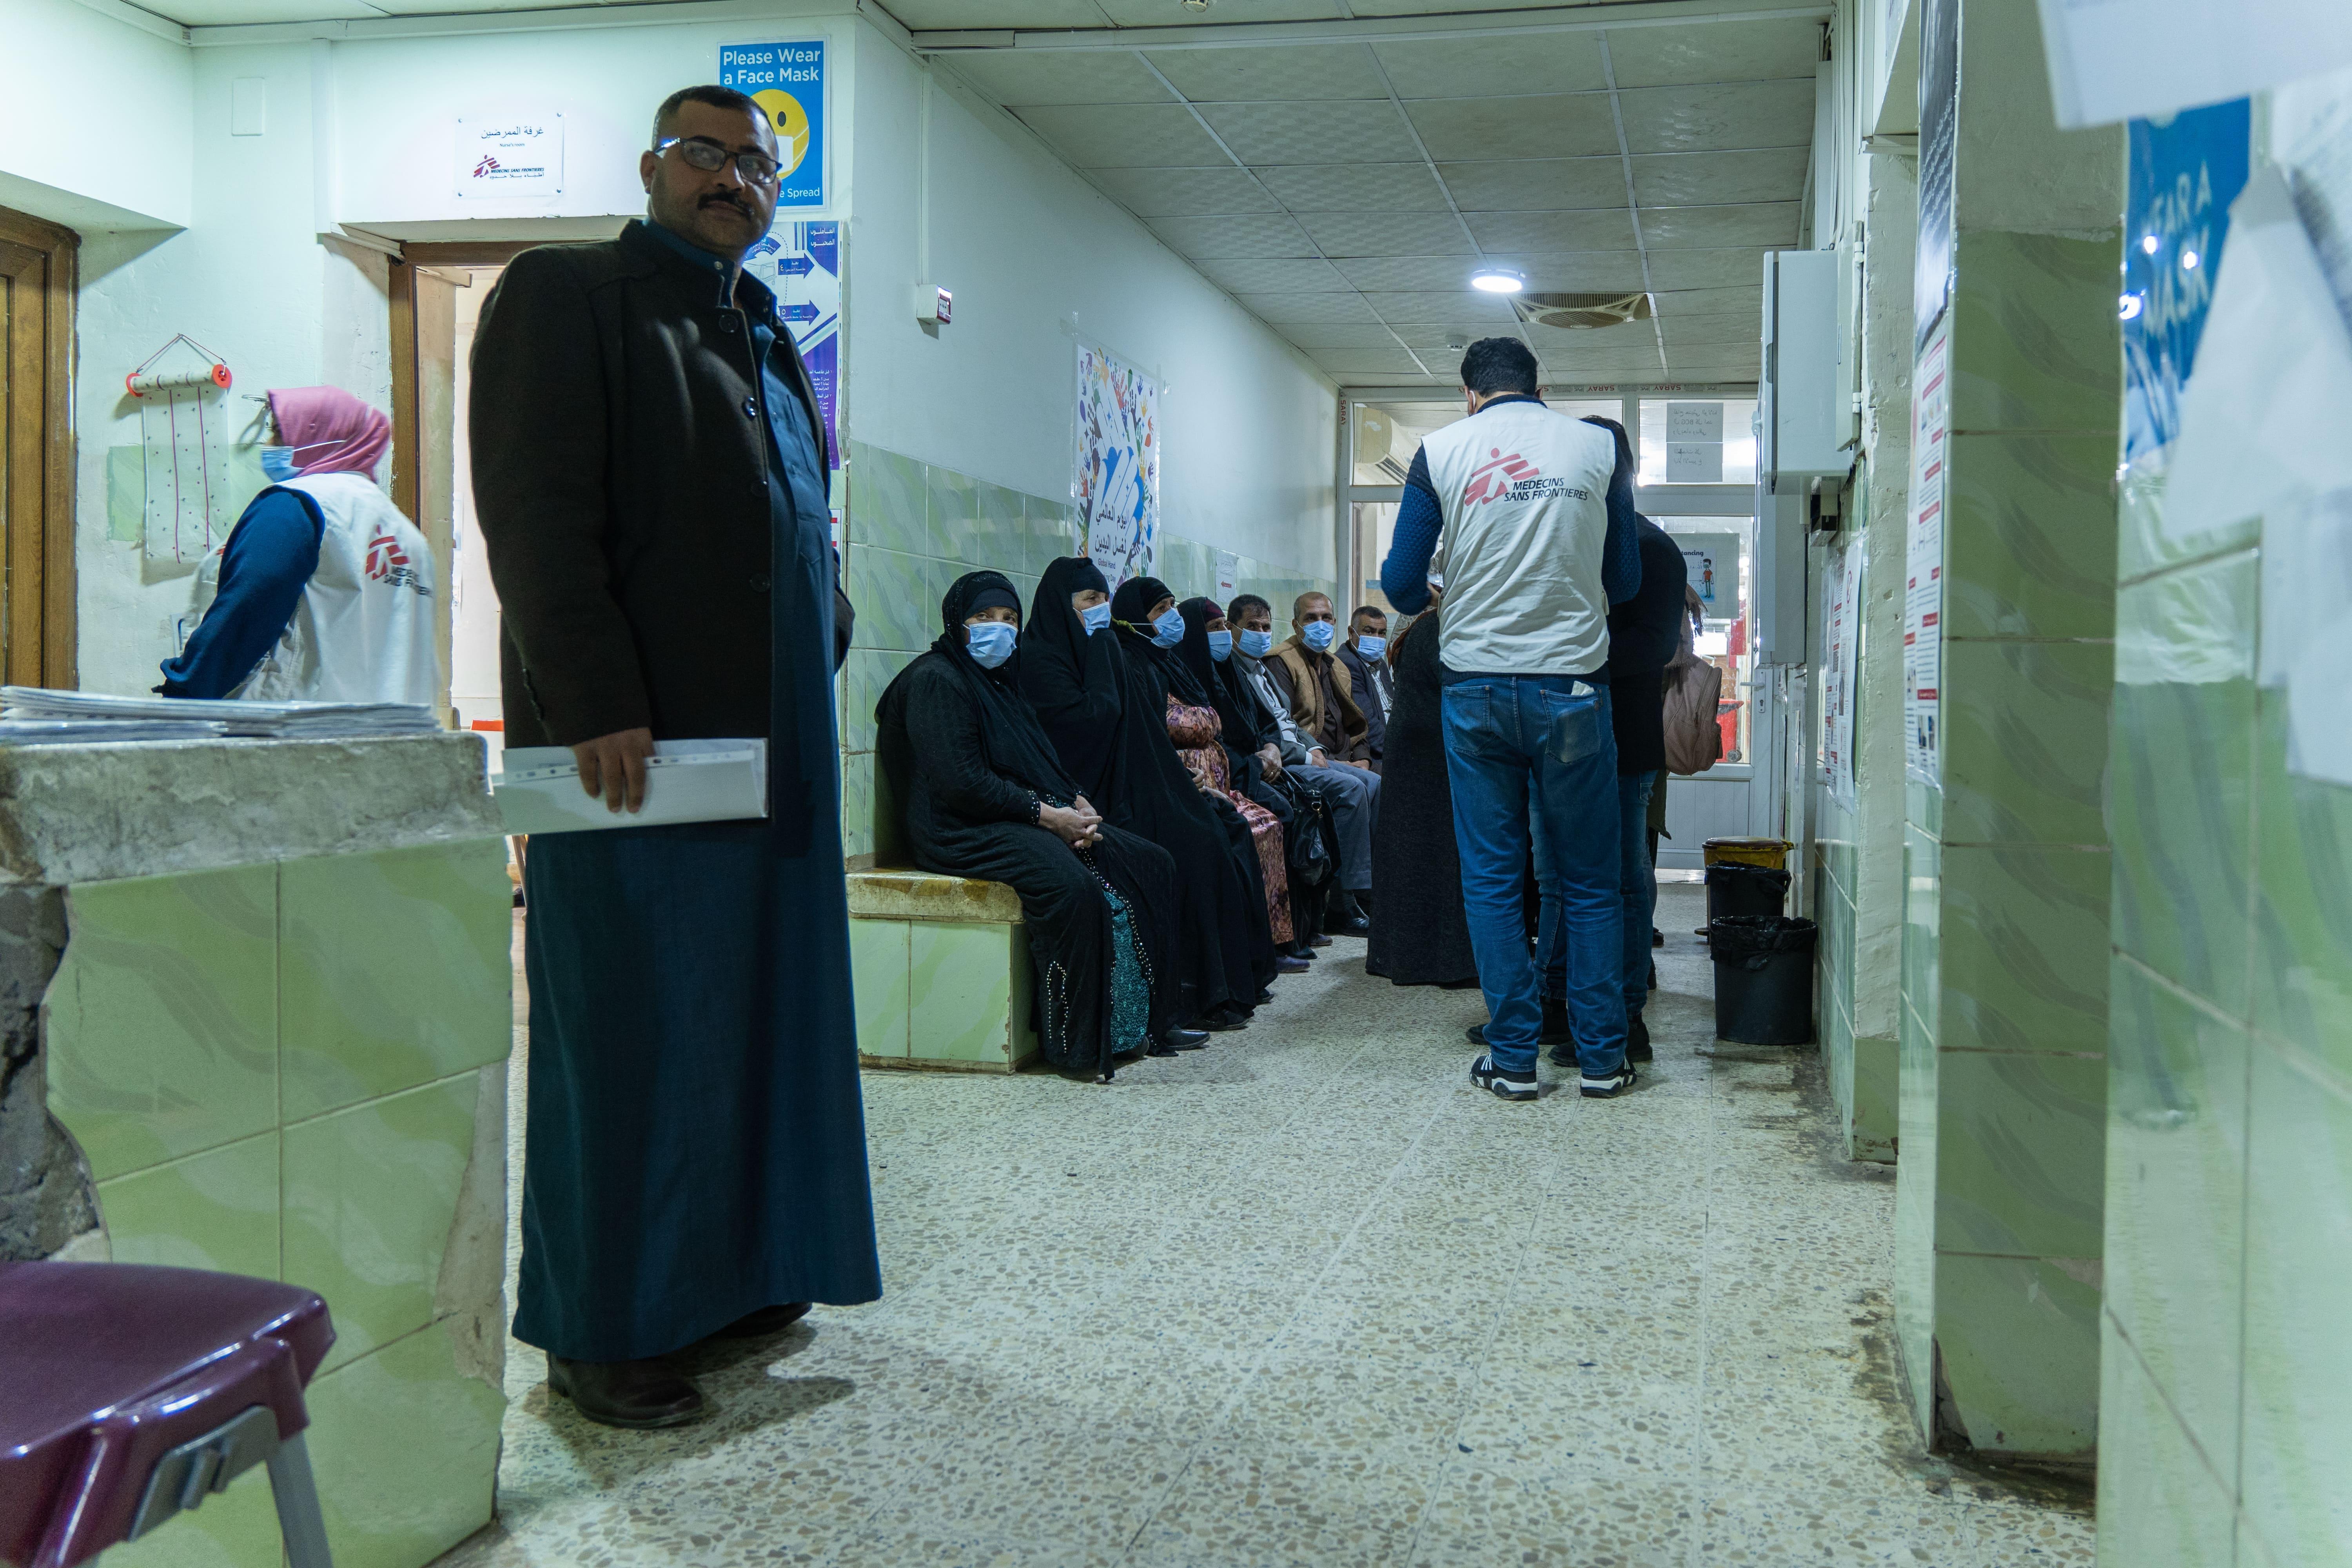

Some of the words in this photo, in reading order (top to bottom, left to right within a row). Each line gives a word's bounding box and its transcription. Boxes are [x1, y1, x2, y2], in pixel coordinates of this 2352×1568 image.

[724, 51, 773, 66] Please
[778, 48, 820, 63] Wear
[724, 73, 732, 85] a
[738, 70, 774, 84] Face
[779, 66, 819, 82] Mask
[481, 126, 521, 139] الممرضين
[524, 126, 544, 138] غرفة
[787, 187, 820, 199] Spread
[1513, 477, 1565, 491] MEDECINS
[1504, 491, 1530, 502] SANS
[1532, 488, 1588, 501] FRONTIERES
[1096, 502, 1115, 525] العالمي
[1117, 508, 1129, 530] اليوم
[1095, 533, 1111, 554] اليدين
[1112, 535, 1126, 556] لغسل
[1098, 558, 1108, 568] Global
